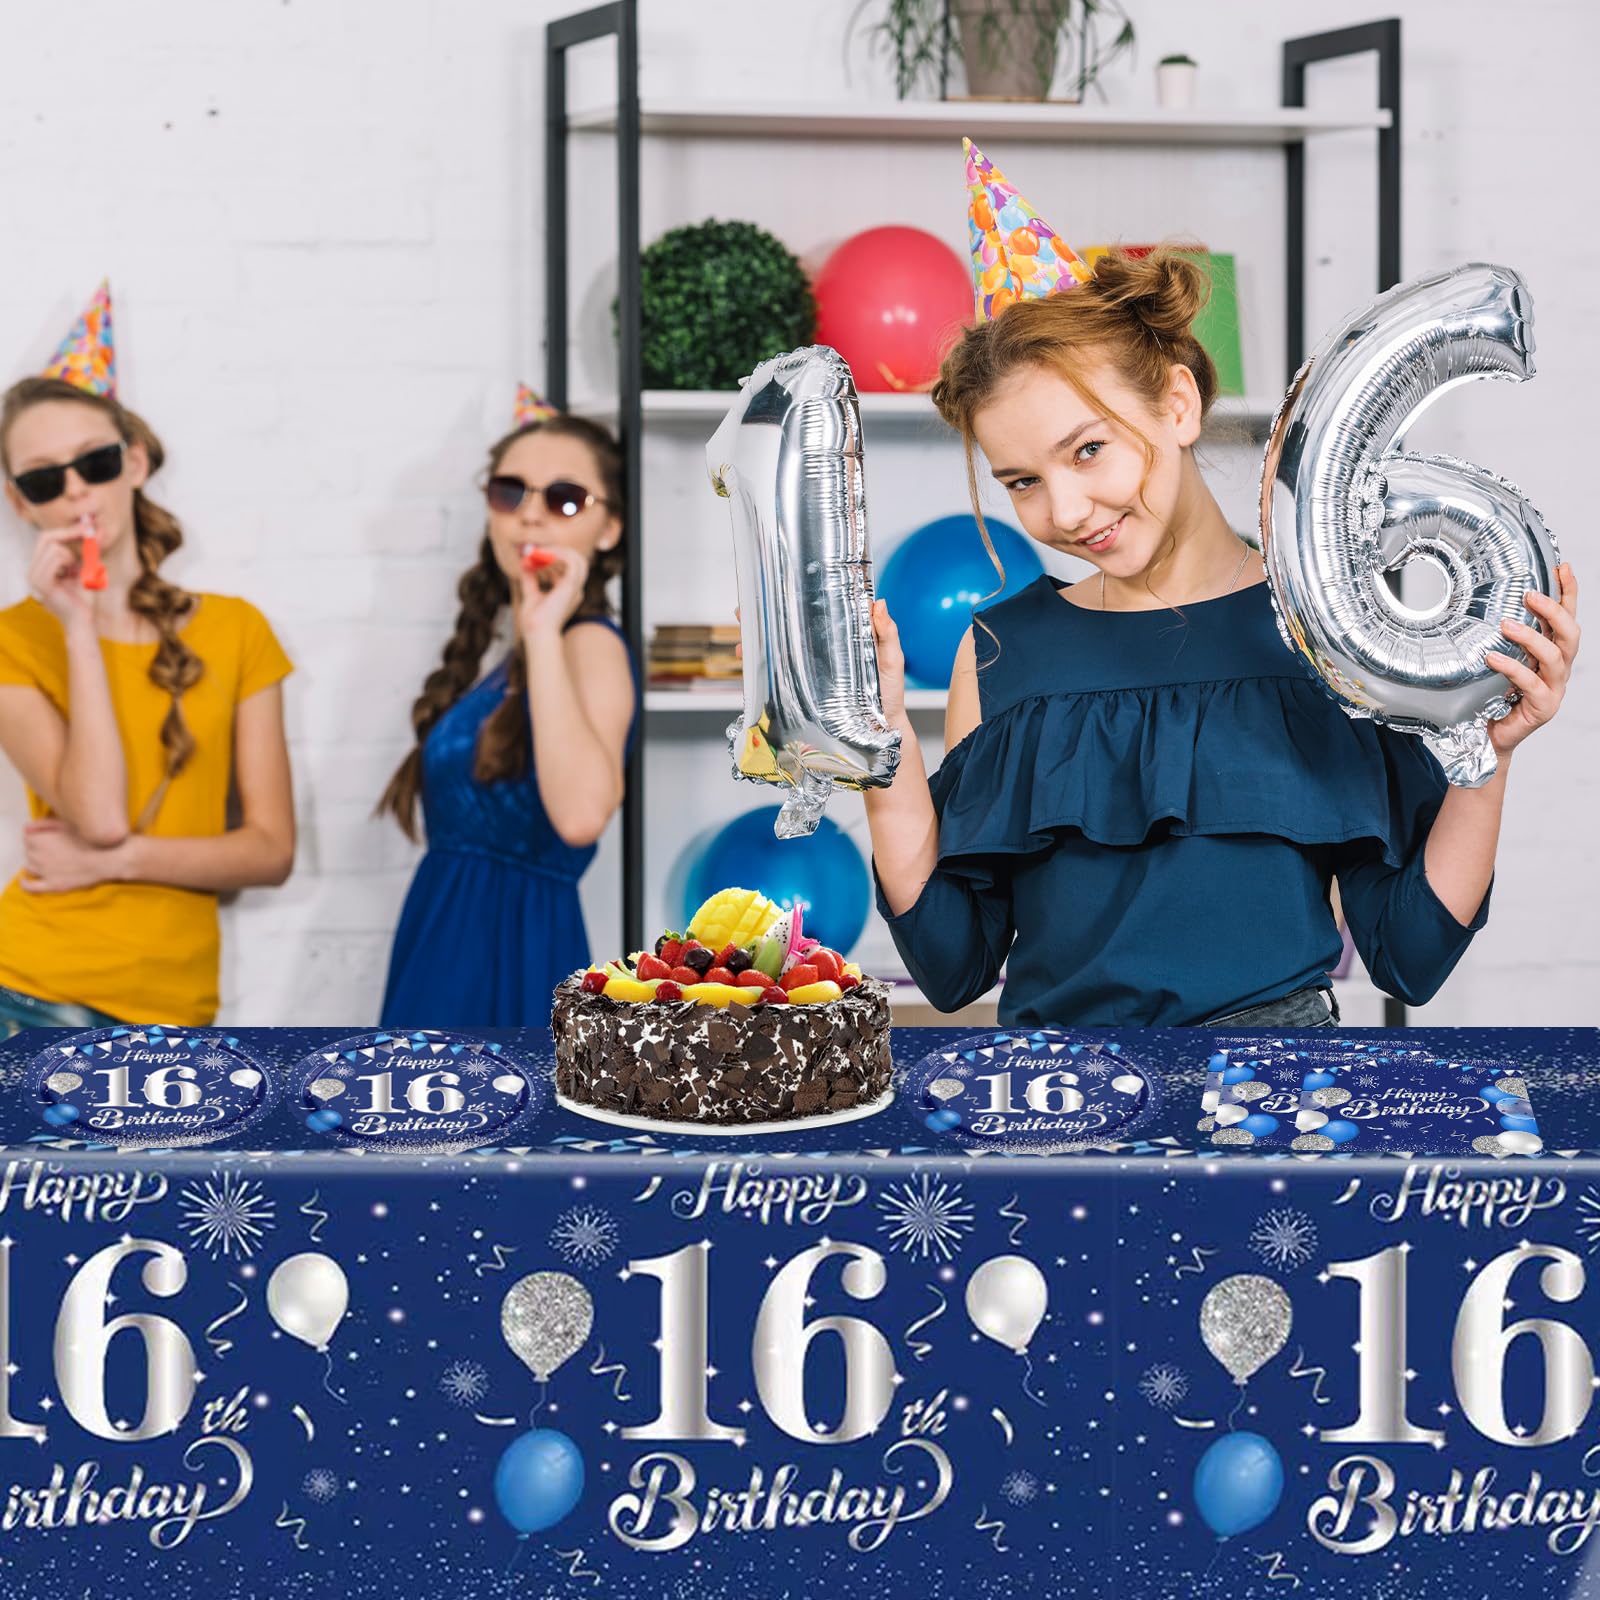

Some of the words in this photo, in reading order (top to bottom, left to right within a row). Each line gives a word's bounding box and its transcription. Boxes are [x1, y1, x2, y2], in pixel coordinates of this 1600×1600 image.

[113, 1049, 190, 1063] Happy
[376, 1055, 453, 1069] Happy
[995, 1055, 1072, 1069] Happy
[1339, 1096, 1490, 1119] Birthday
[1372, 1088, 1457, 1103] Happy
[88, 1105, 225, 1129] Birthday
[351, 1111, 488, 1135] Birthday
[970, 1111, 1107, 1135] Birthday
[671, 1162, 867, 1225] Happy
[1370, 1164, 1566, 1227] Happy
[2, 1436, 254, 1549] irthday
[608, 1437, 953, 1552] Birthday
[1307, 1445, 1600, 1555] Birthday
